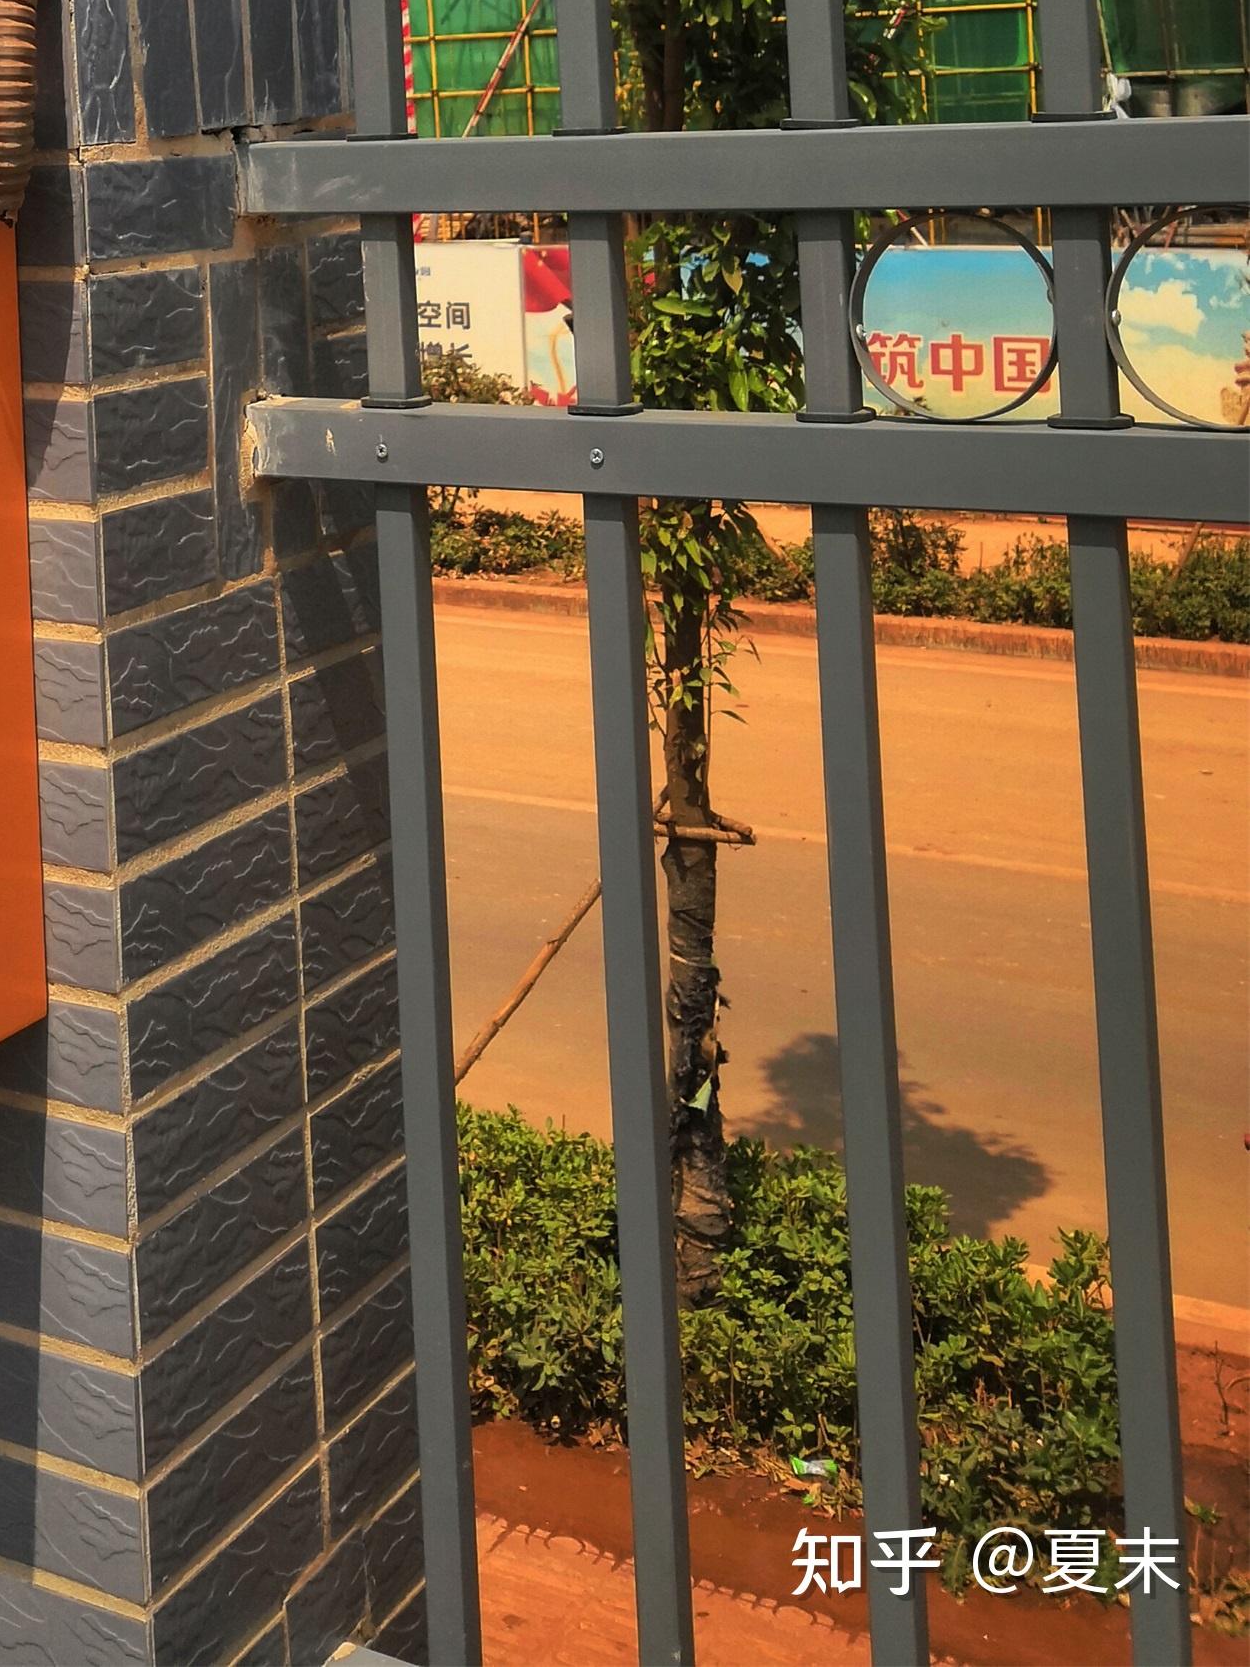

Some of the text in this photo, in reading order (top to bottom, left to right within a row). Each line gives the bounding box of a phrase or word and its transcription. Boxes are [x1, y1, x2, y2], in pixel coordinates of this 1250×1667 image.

[417, 300, 471, 330] 空间
[867, 332, 1052, 394] 筑中国
